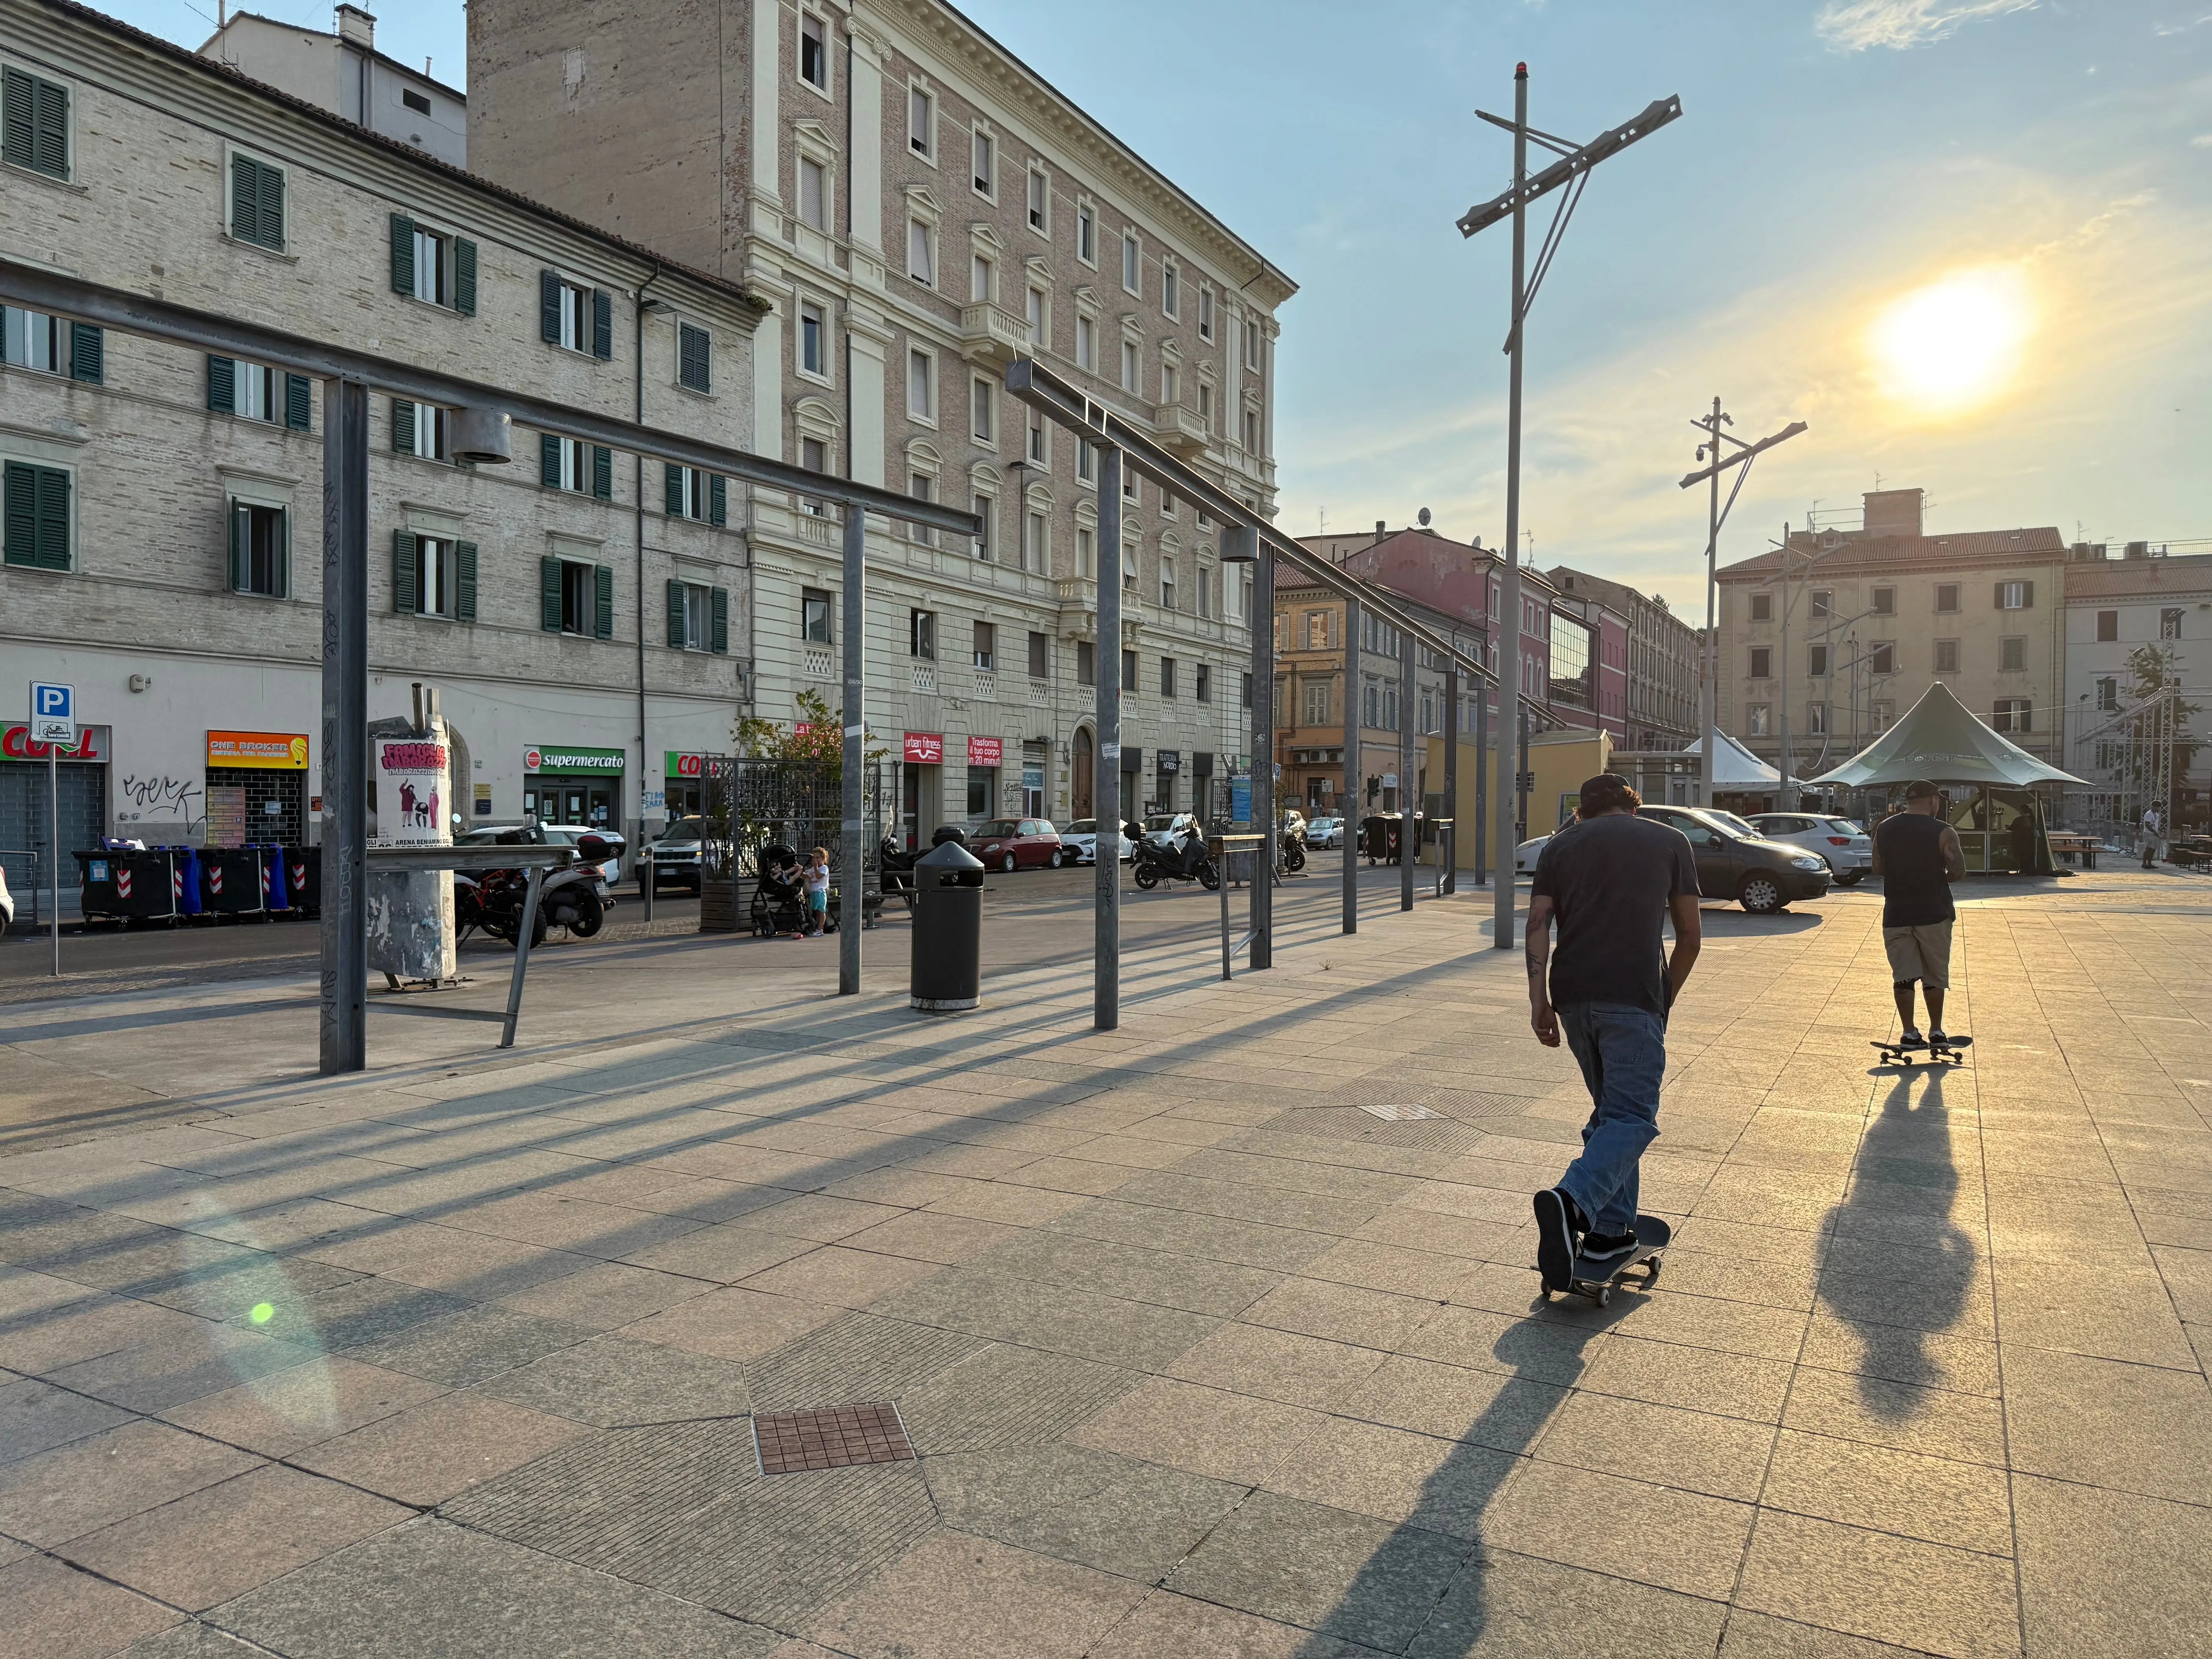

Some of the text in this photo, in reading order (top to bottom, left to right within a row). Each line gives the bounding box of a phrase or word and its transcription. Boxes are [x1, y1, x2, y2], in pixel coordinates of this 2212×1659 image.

[44, 689, 64, 713] P
[2, 726, 97, 757] COL
[239, 742, 288, 751] BROKER
[905, 736, 941, 749] urban fitness
[972, 737, 998, 747] Trasforma
[384, 743, 445, 758] FAMIGLIA
[974, 746, 983, 754] tuo
[984, 749, 1000, 757] corpo
[381, 756, 447, 769] IMBARAZZI
[544, 755, 623, 768] supermercato
[969, 755, 1001, 765] in 20 minuti
